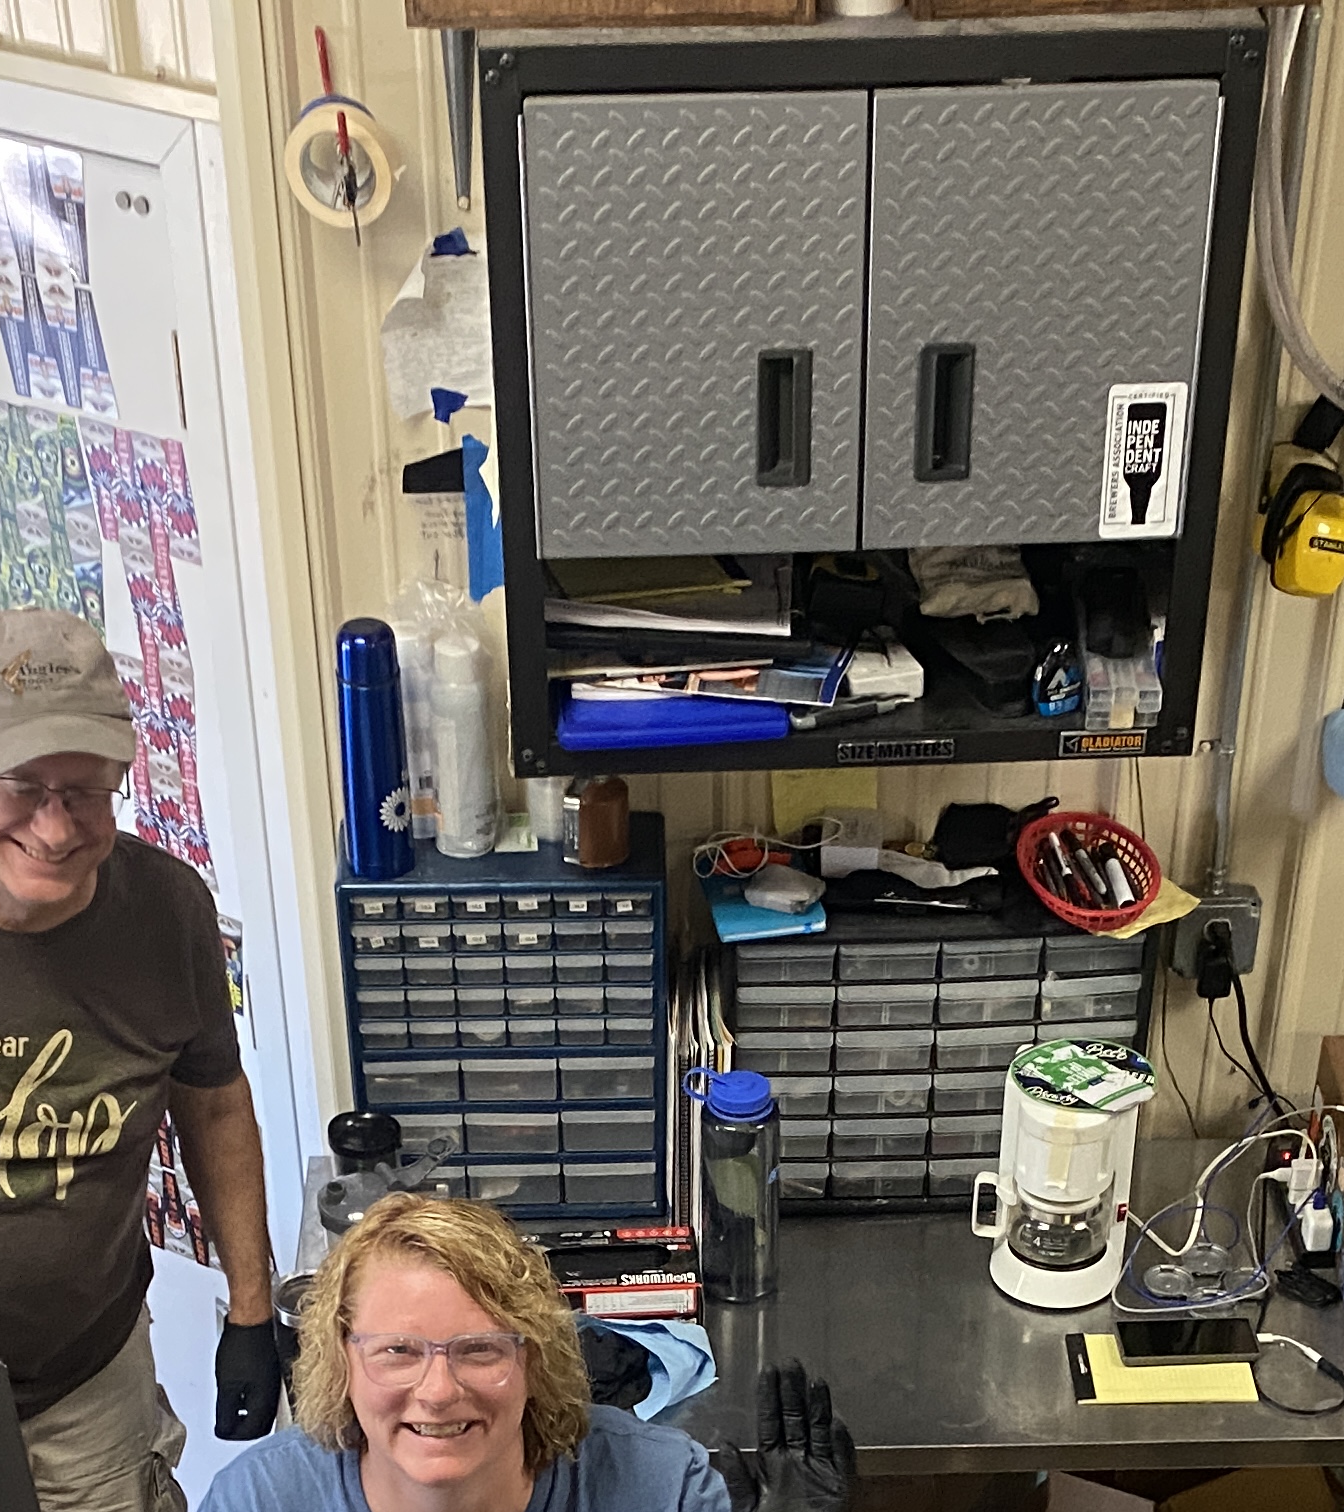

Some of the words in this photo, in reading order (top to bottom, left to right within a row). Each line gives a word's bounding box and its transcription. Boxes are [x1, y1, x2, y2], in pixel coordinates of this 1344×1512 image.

[1127, 419, 1160, 435] INDE
[1112, 403, 1125, 468] ASSOCIATION
[1126, 434, 1155, 450] PEN
[1125, 448, 1163, 463] DENT
[1124, 463, 1157, 474] CRAFT
[1108, 471, 1120, 519] BREWERS
[1081, 734, 1143, 749] GLADIATOR
[838, 742, 876, 763] SIZE
[877, 738, 955, 760] MATTERS
[620, 1272, 696, 1286] GLOVEWORKS
